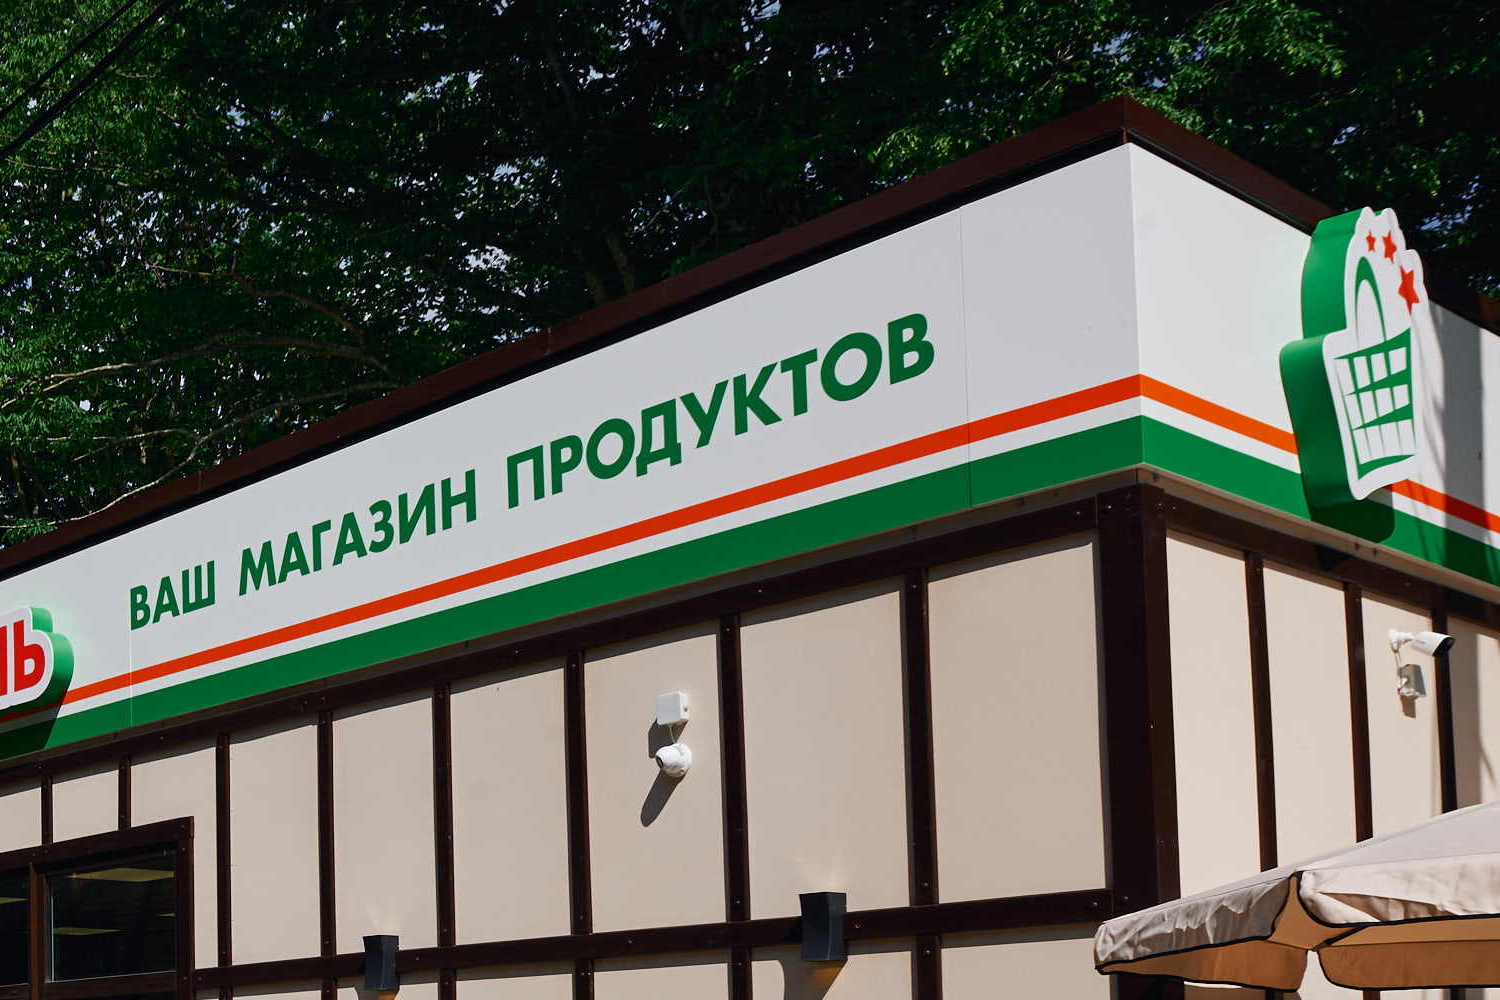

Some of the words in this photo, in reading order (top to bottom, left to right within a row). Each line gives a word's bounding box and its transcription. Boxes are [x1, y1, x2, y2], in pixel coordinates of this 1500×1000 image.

[130, 560, 216, 630] ВАШ
[238, 468, 477, 596] МАГАЗИН
[506, 312, 936, 510] ПРОДУКТОВ
